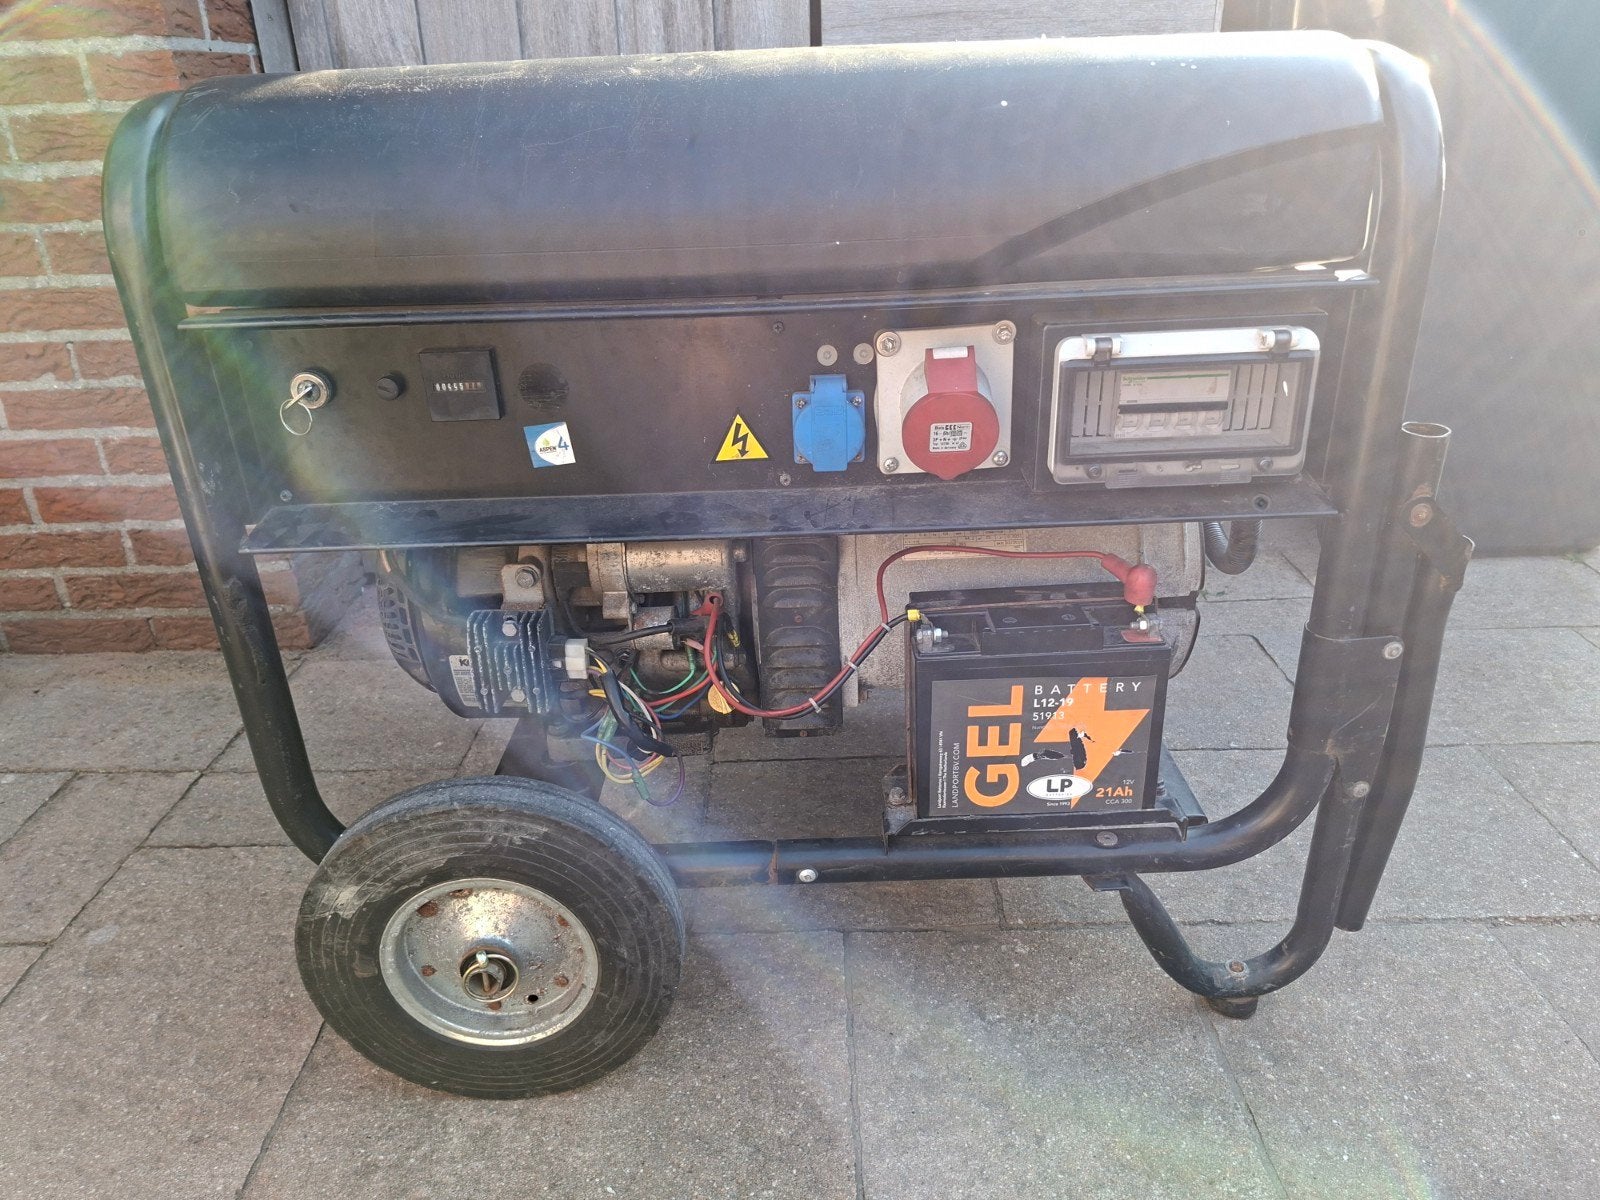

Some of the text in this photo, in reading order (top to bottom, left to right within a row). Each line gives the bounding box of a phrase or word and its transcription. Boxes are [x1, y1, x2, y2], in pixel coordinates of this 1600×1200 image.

[558, 436, 569, 450] 4
[1034, 681, 1142, 695] BATTERY
[1033, 698, 1074, 708] L12-19
[1032, 711, 1065, 721] 51913
[964, 685, 1024, 807] GEL
[1046, 779, 1073, 792] LP
[1095, 786, 1133, 798] 21Ah
